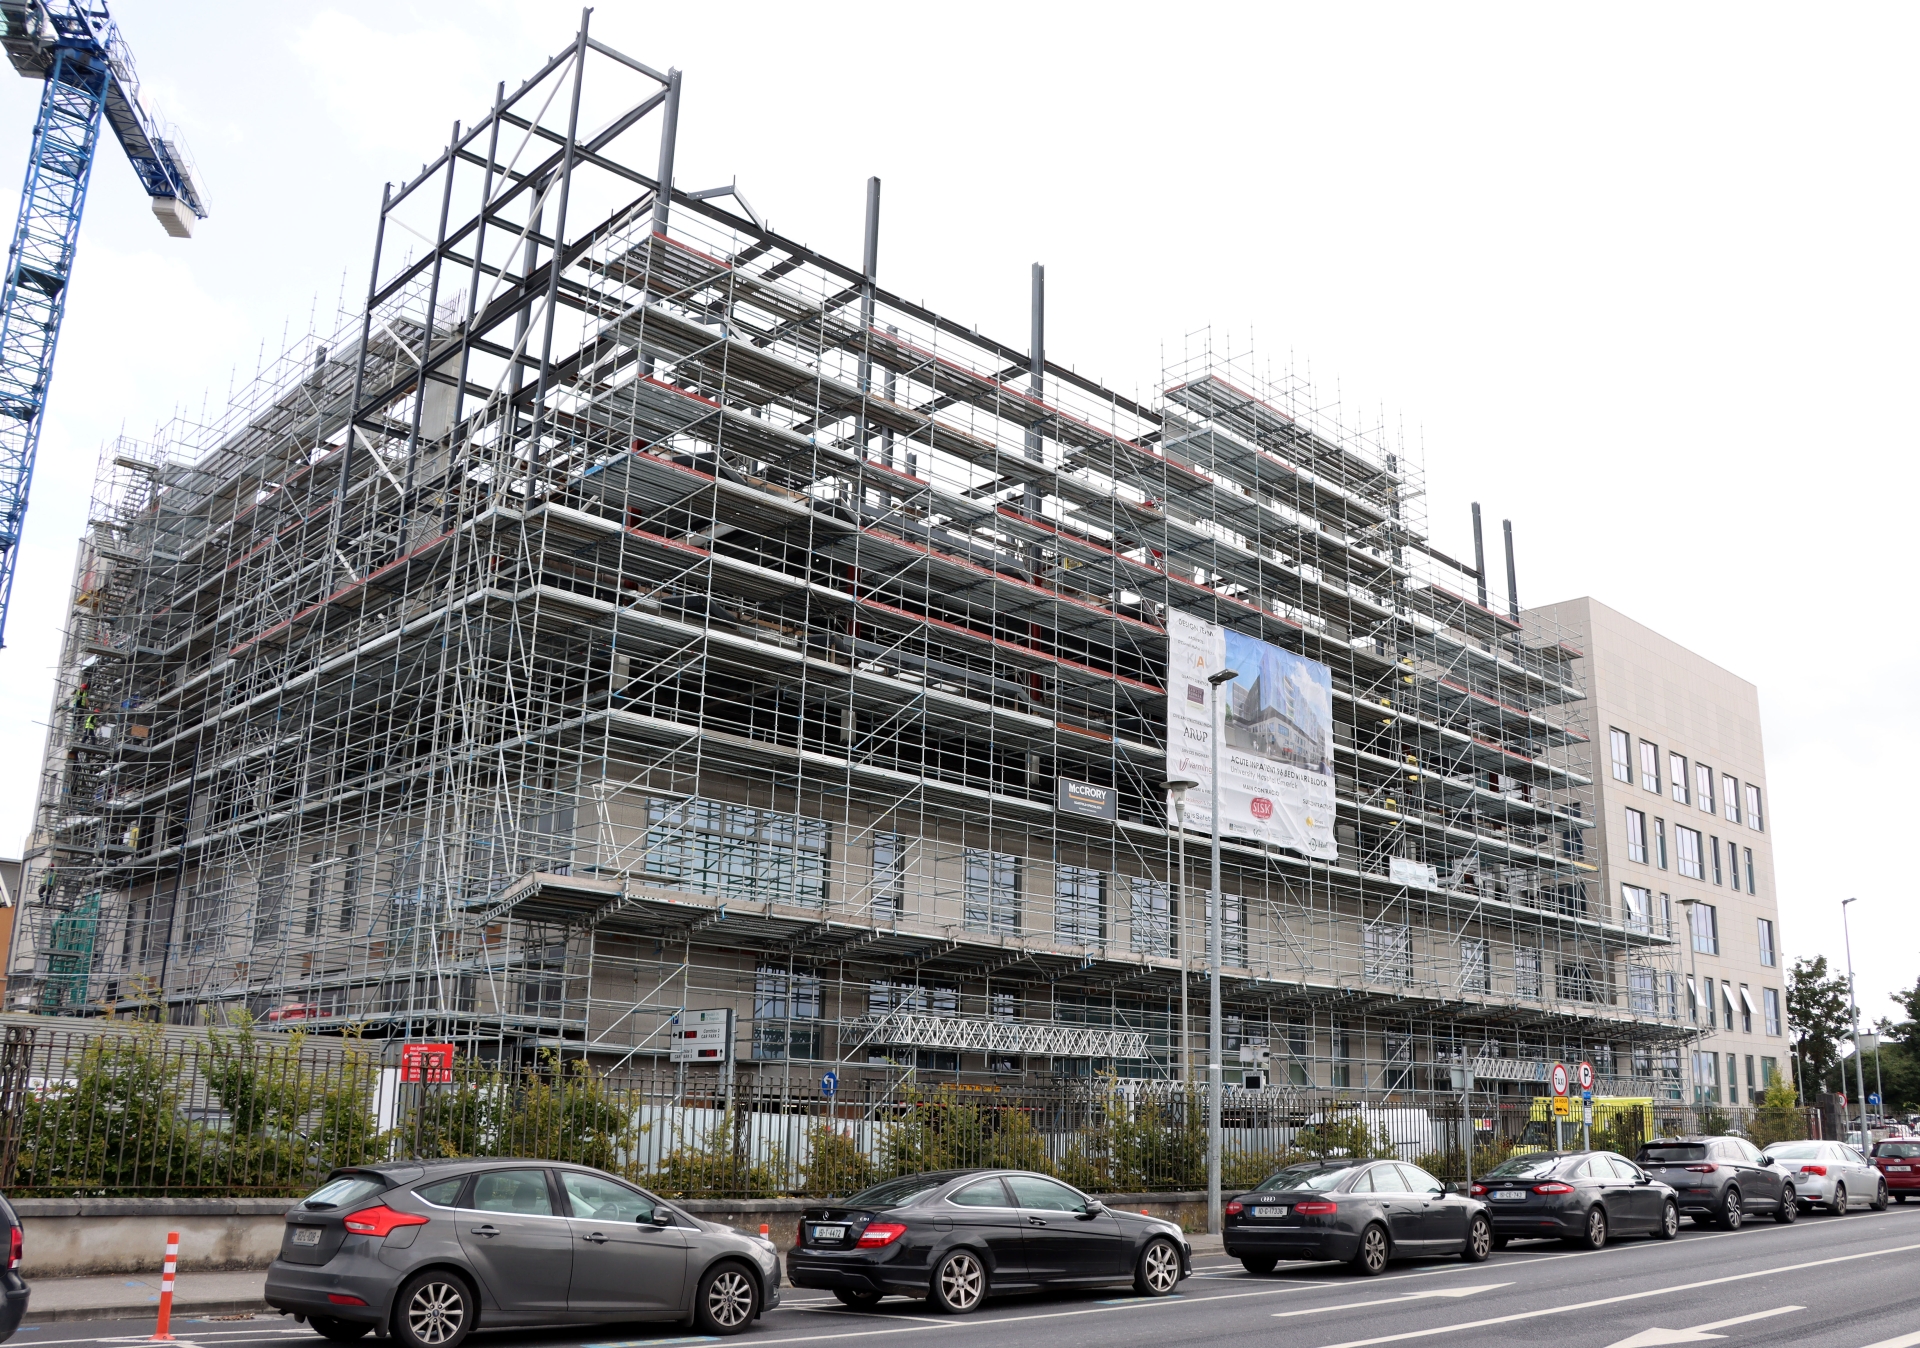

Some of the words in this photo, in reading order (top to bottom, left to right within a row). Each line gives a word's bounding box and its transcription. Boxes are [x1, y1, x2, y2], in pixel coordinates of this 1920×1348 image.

[1178, 618, 1198, 632] DESIGN
[1183, 726, 1208, 742] ARUP
[1230, 755, 1249, 767] ACUTE
[1249, 760, 1276, 773] INPATIENT
[1284, 769, 1295, 779] BED
[1310, 777, 1328, 787] BLOCK
[1230, 765, 1256, 779] University
[1068, 782, 1107, 799] McCRORY
[1242, 783, 1253, 792] MAIN
[1252, 802, 1271, 814] SISK
